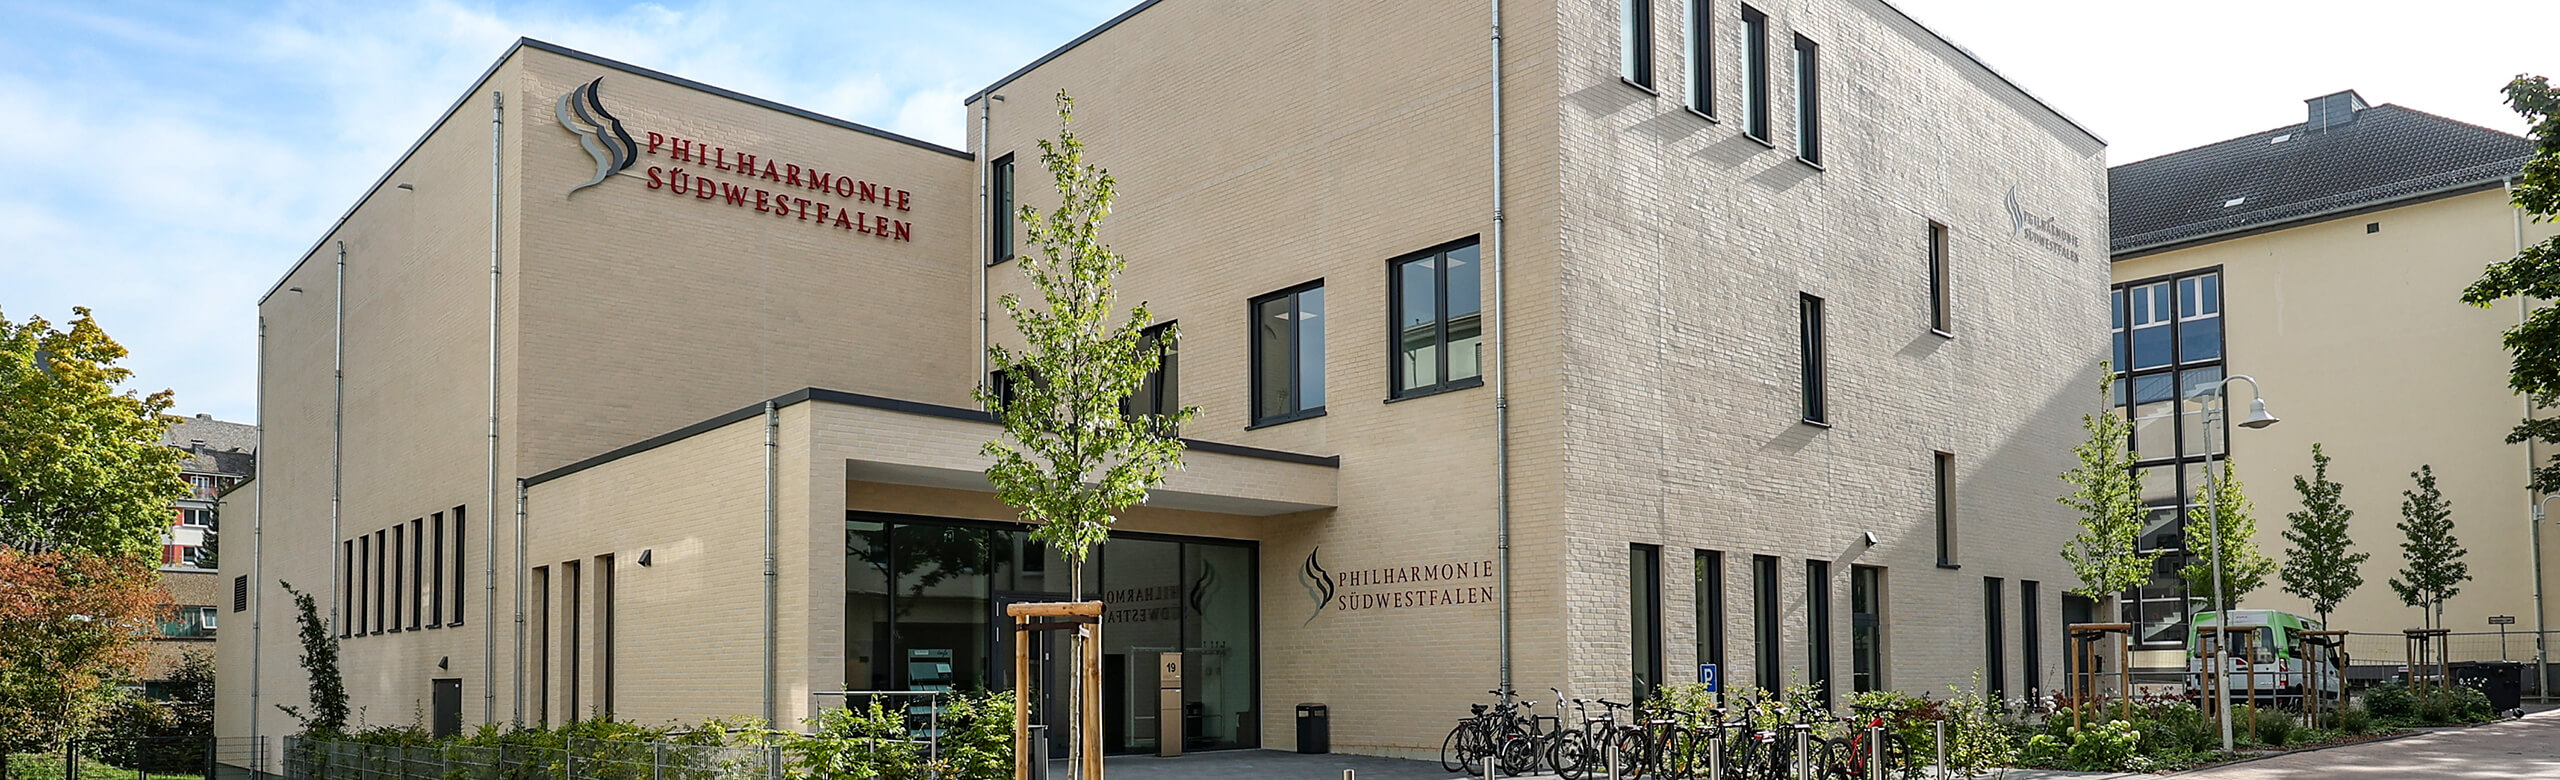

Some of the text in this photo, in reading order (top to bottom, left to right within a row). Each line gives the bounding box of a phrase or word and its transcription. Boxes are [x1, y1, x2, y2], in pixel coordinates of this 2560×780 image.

[647, 131, 911, 212] PHILHARMONIE
[647, 166, 912, 242] SÜDWESTFALEN
[1338, 560, 1493, 587] PHILHARMONIE
[1338, 586, 1494, 611] SÜDWESTFALEN
[1166, 662, 1176, 673] 19
[1704, 668, 1713, 684] P
